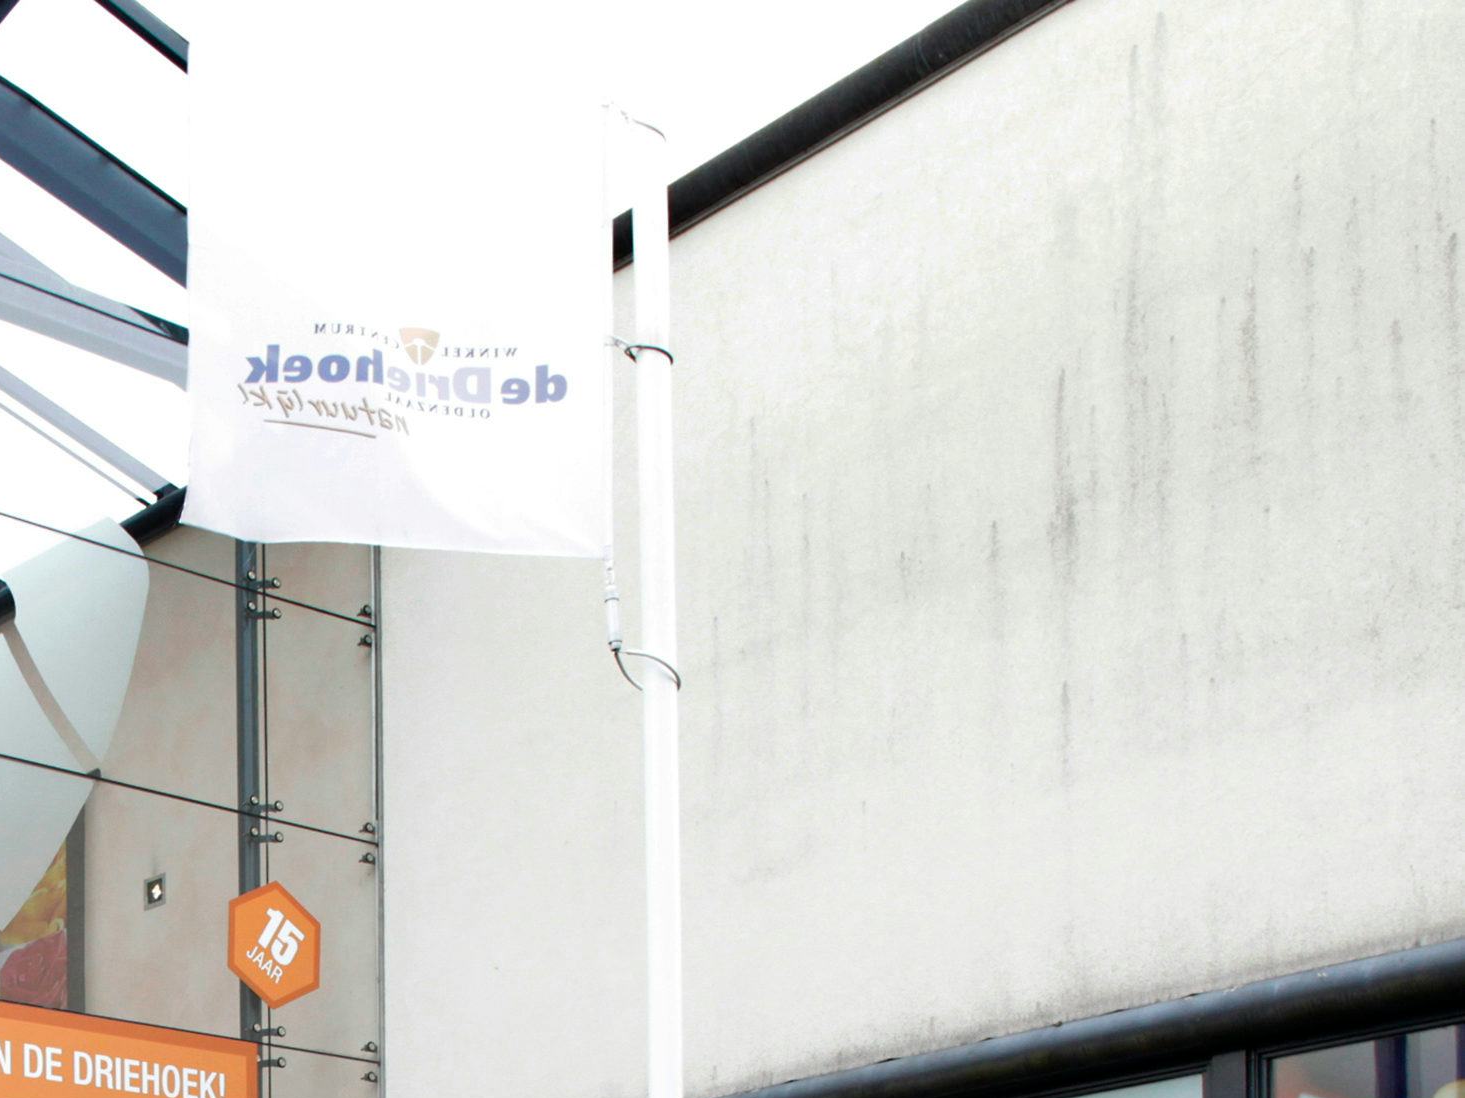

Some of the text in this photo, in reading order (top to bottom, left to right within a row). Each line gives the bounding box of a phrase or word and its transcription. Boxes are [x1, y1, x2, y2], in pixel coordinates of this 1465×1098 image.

[257, 907, 306, 967] 15
[245, 945, 284, 984] JAAR
[23, 1044, 64, 1083] DE
